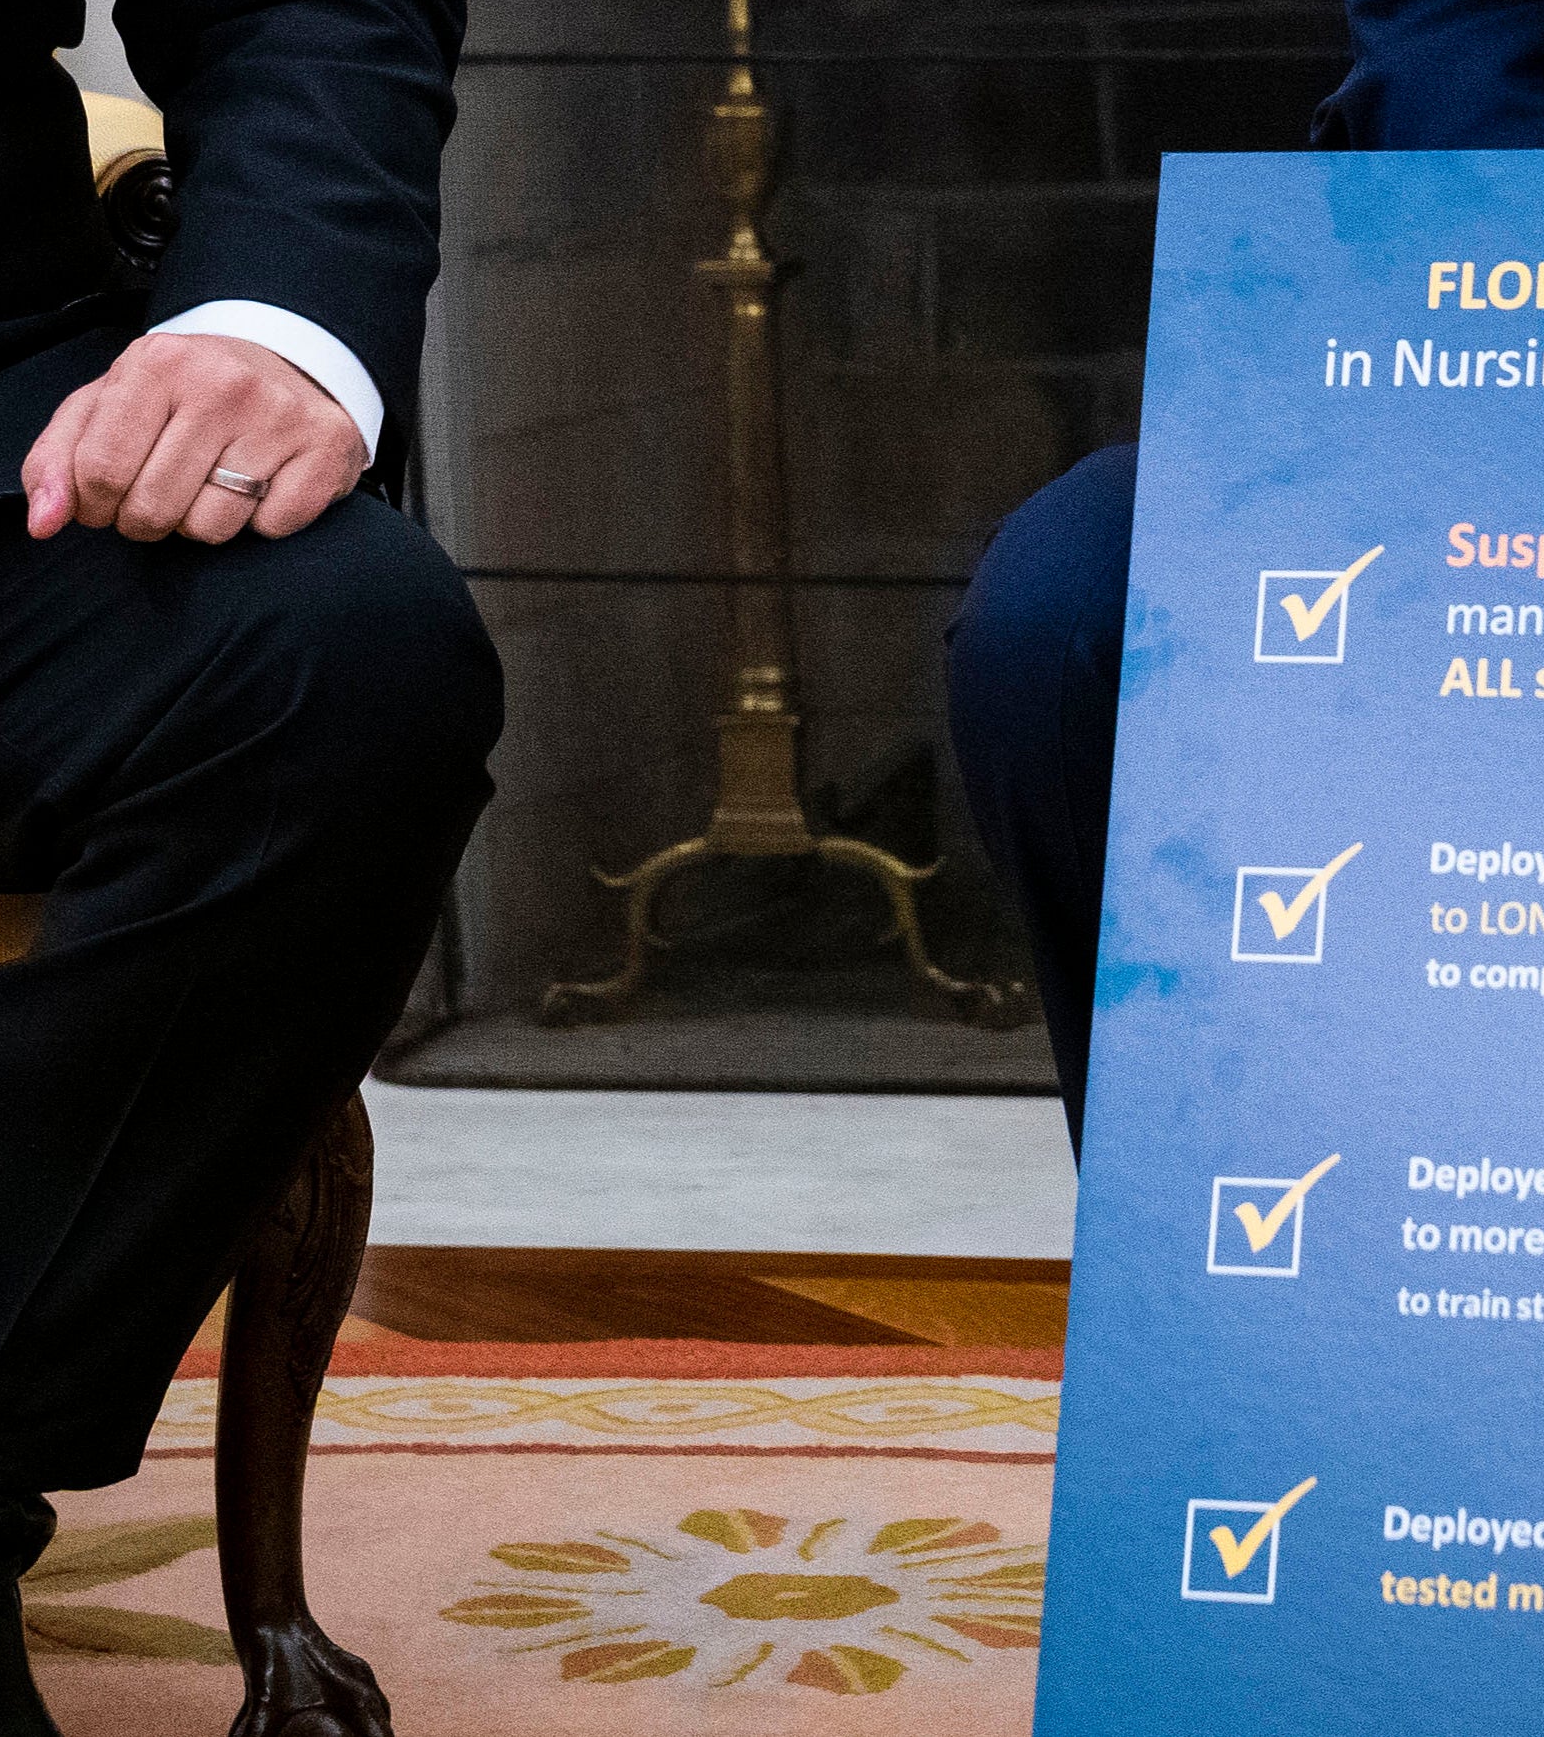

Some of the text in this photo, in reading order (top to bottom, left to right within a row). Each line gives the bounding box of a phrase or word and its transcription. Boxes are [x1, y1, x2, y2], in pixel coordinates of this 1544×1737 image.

[1325, 338, 1372, 387] in
[1440, 657, 1522, 698] ALL
[1431, 903, 1468, 933] to
[1426, 959, 1461, 987] to
[1402, 1218, 1441, 1250] to
[1397, 1288, 1430, 1316] to
[1437, 1289, 1510, 1318] train
[1380, 1570, 1499, 1610] tested
